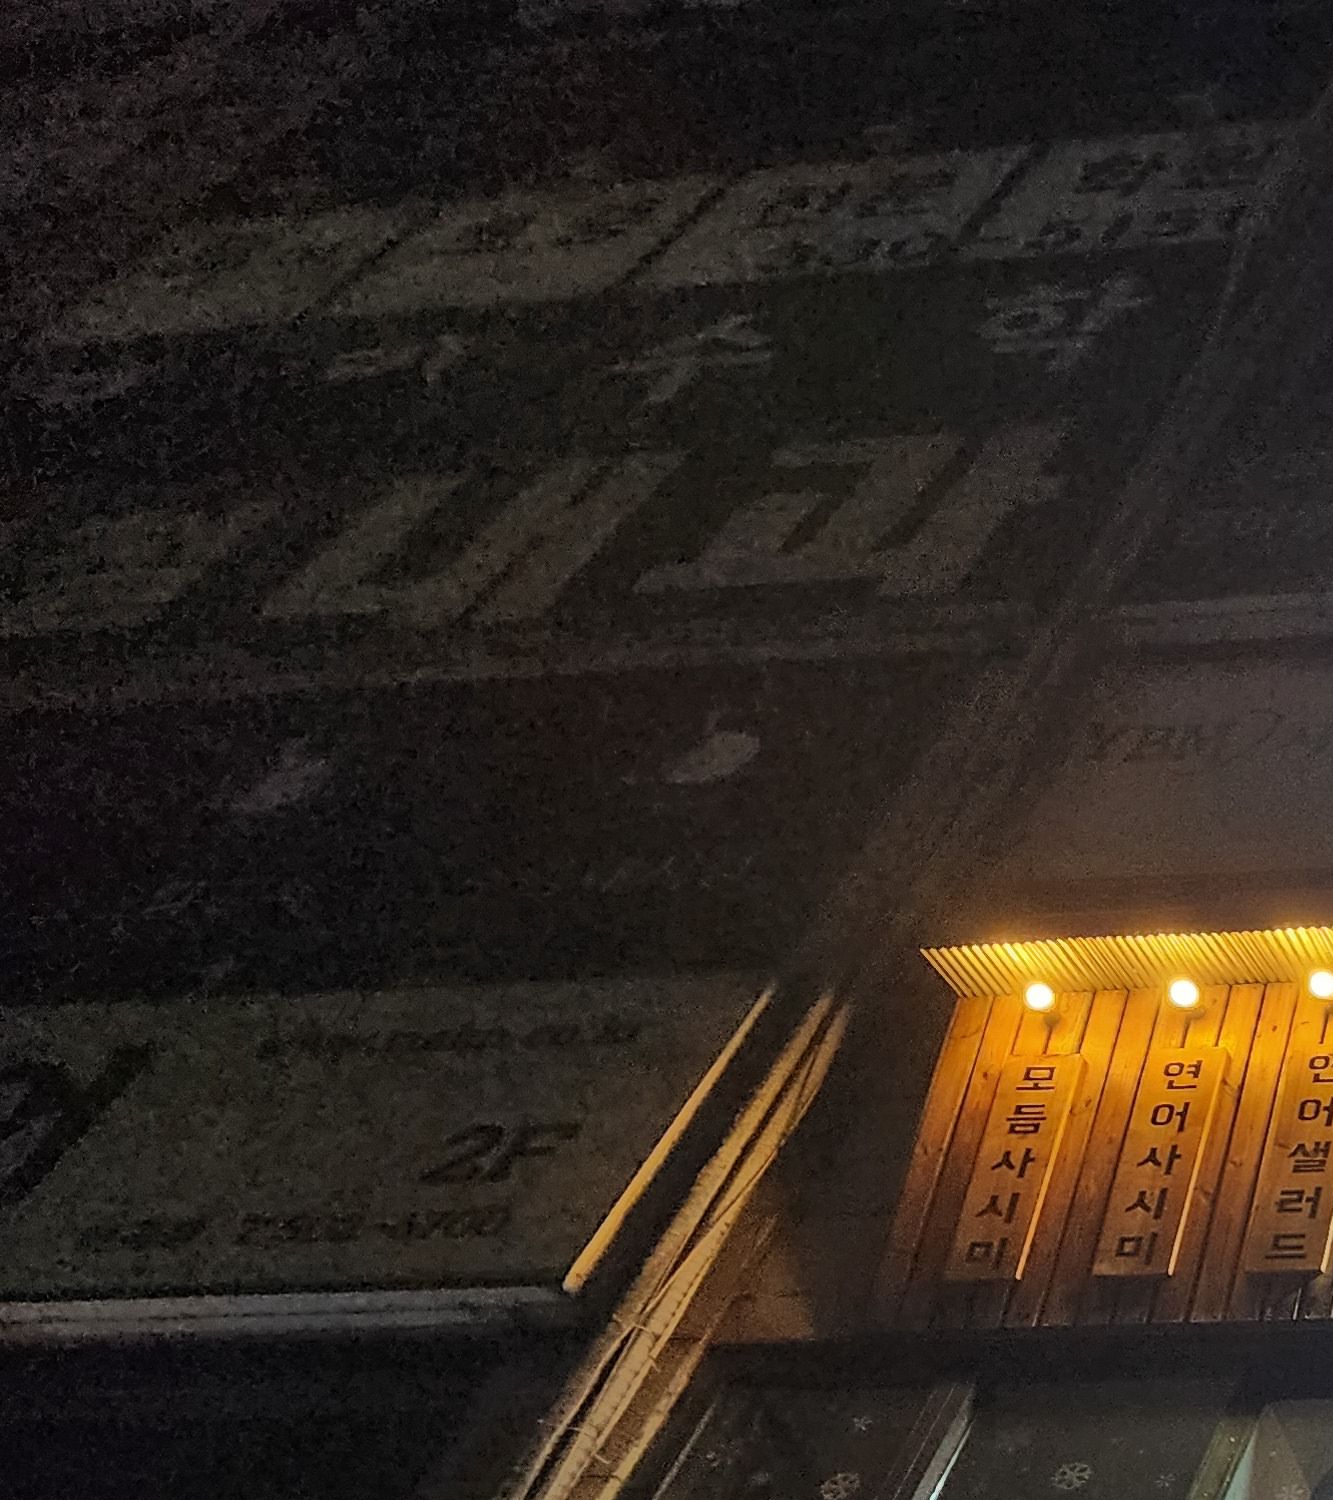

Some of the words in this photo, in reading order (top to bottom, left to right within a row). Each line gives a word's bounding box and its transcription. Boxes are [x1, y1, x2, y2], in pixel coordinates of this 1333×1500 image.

[418, 1120, 582, 1185] 2F
[966, 1065, 1057, 1268] 모듬사시미
[1116, 1059, 1202, 1266] 연어사시미
